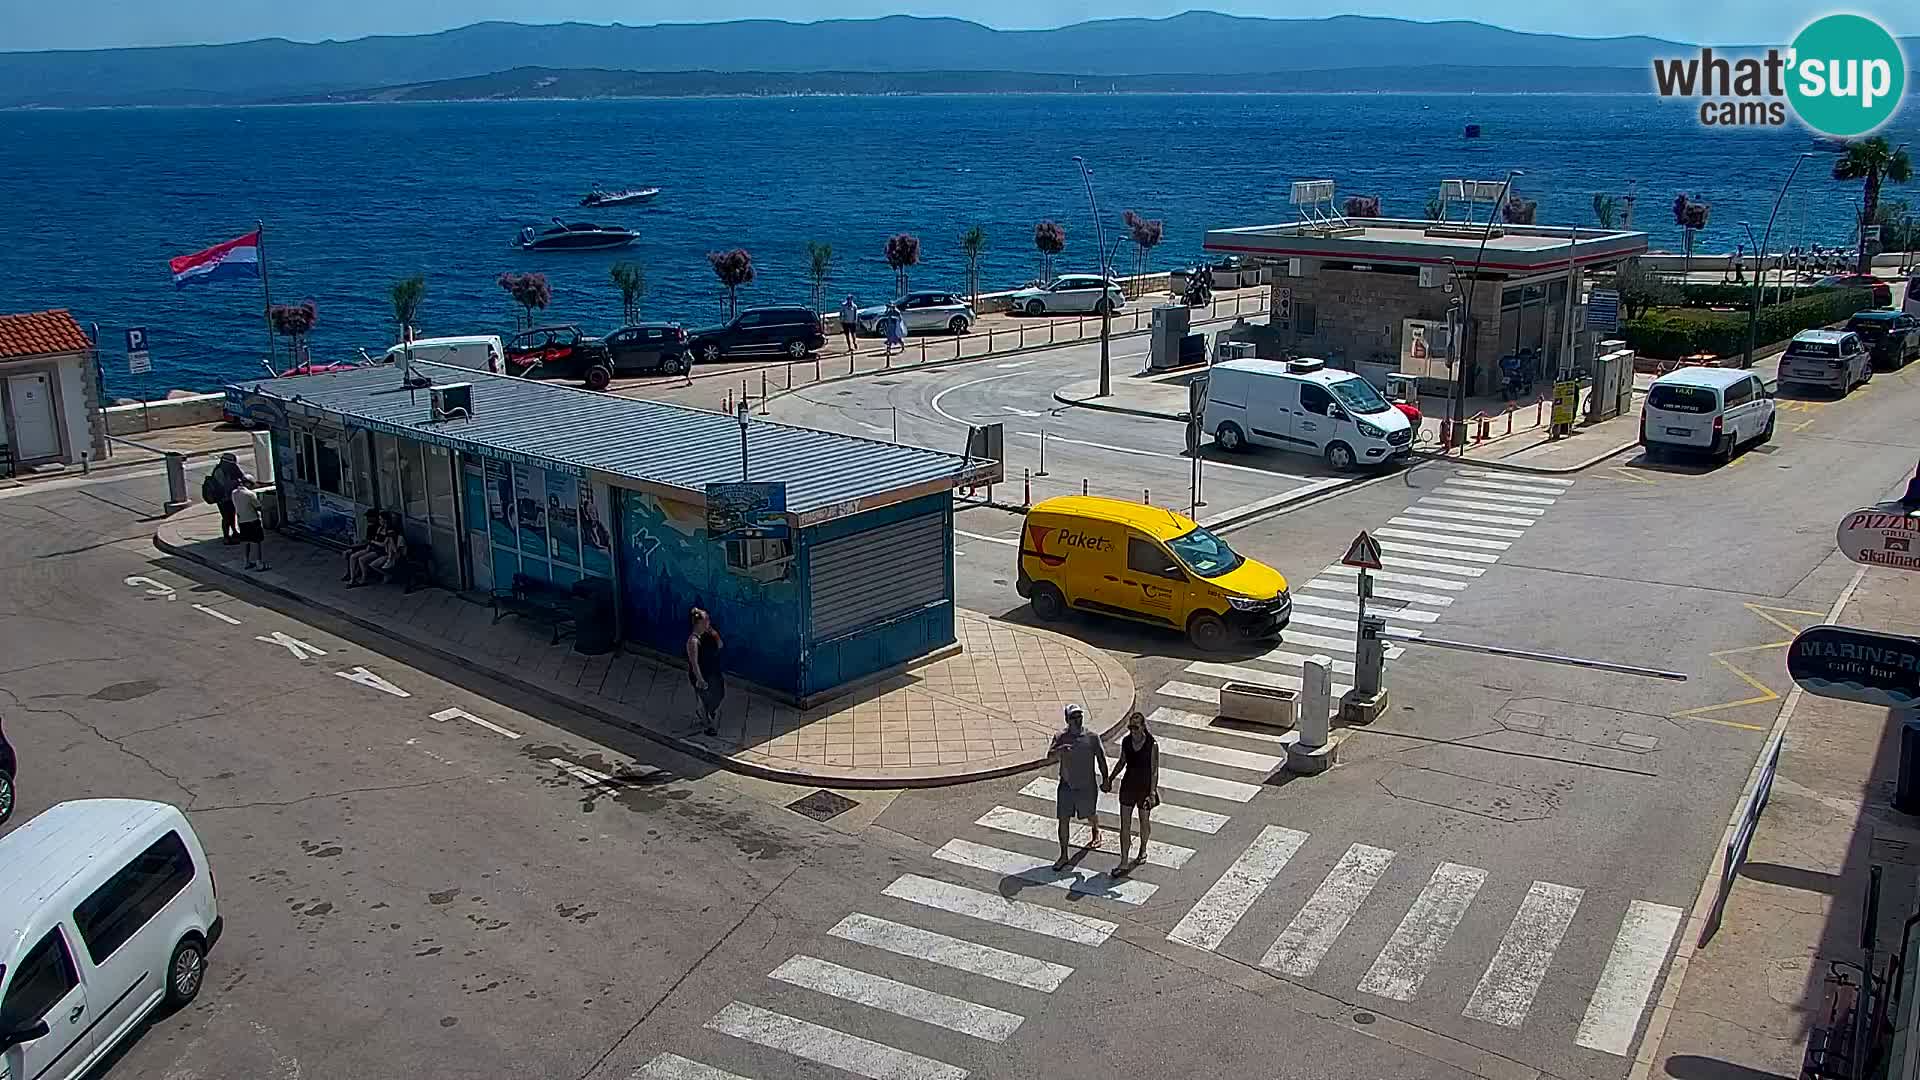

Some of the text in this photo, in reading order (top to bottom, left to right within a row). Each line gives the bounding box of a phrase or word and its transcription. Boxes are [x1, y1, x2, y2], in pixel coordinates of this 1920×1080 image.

[1675, 387, 1694, 396] TAXI
[494, 448, 527, 465] STATION
[528, 457, 554, 471] TICKET
[555, 463, 582, 477] OFFICE
[1881, 529, 1917, 541] GRILL
[1827, 660, 1897, 680] caffe bar
